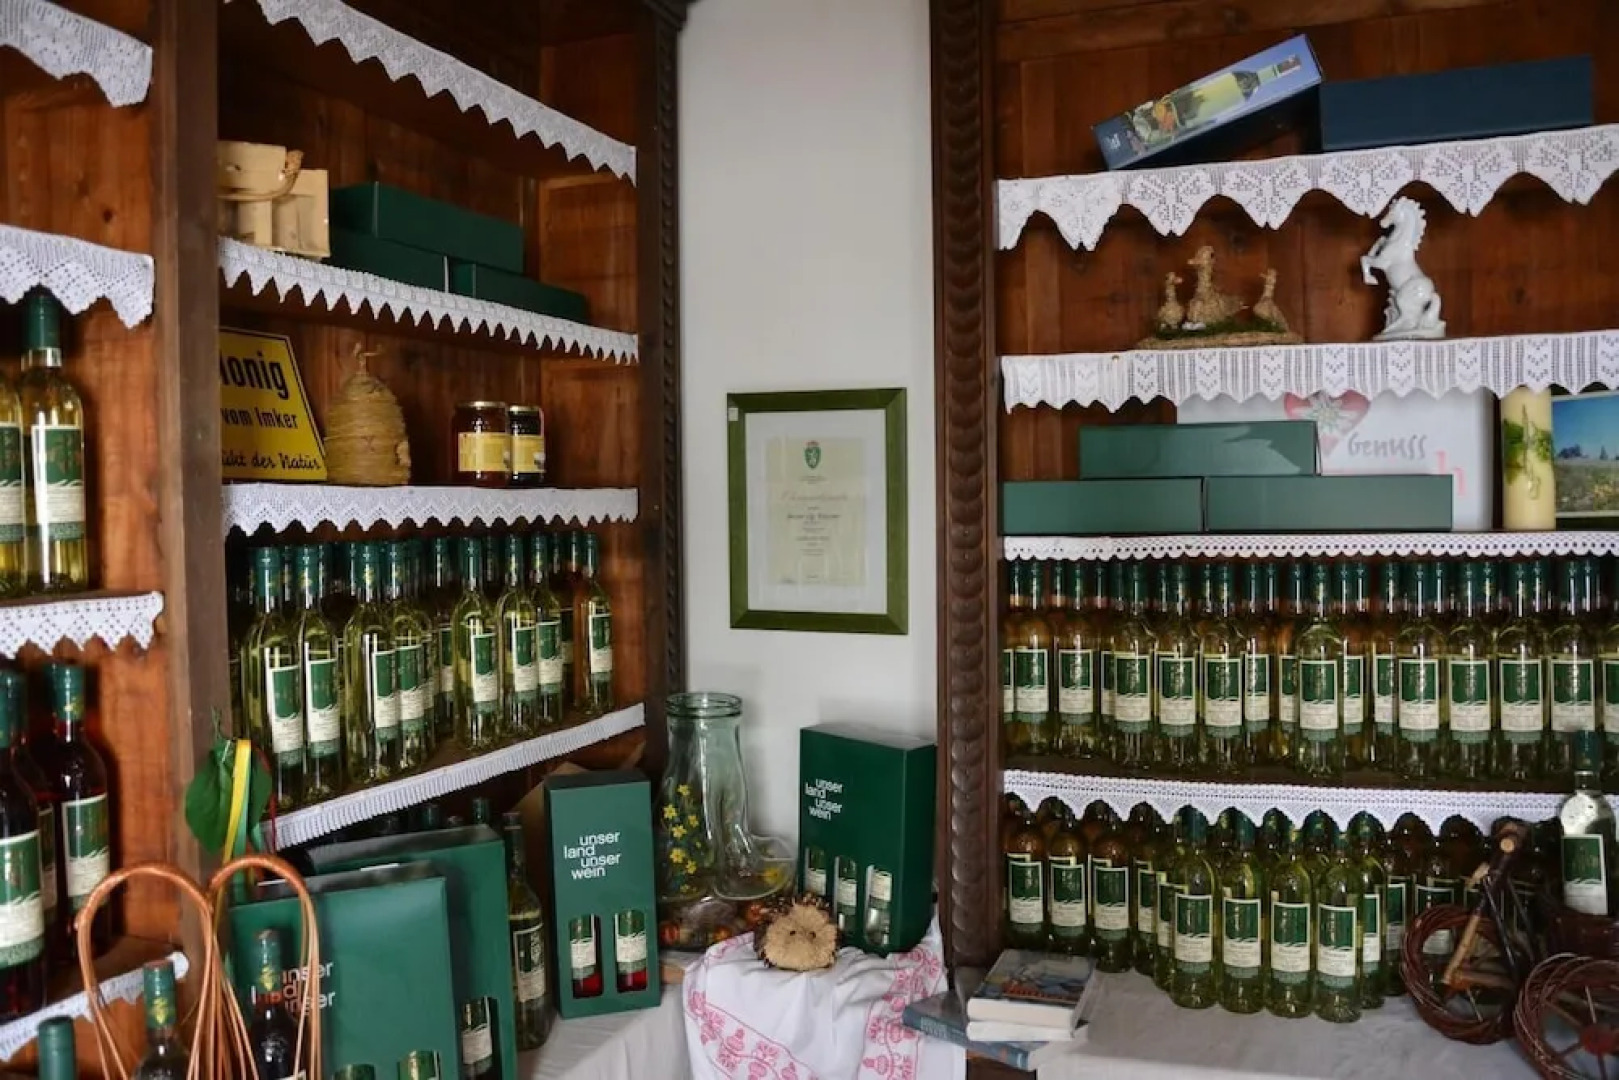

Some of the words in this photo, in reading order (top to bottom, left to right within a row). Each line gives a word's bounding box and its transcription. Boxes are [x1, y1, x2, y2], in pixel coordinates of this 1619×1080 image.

[254, 406, 299, 429] Imker
[1347, 431, 1428, 460] Genuss
[804, 782, 827, 799] land
[815, 778, 843, 793] unser
[808, 805, 831, 821] wein
[815, 798, 843, 814] unser
[579, 831, 621, 846] unser
[563, 844, 595, 859] land
[580, 853, 622, 867] unser
[571, 866, 606, 880] wein
